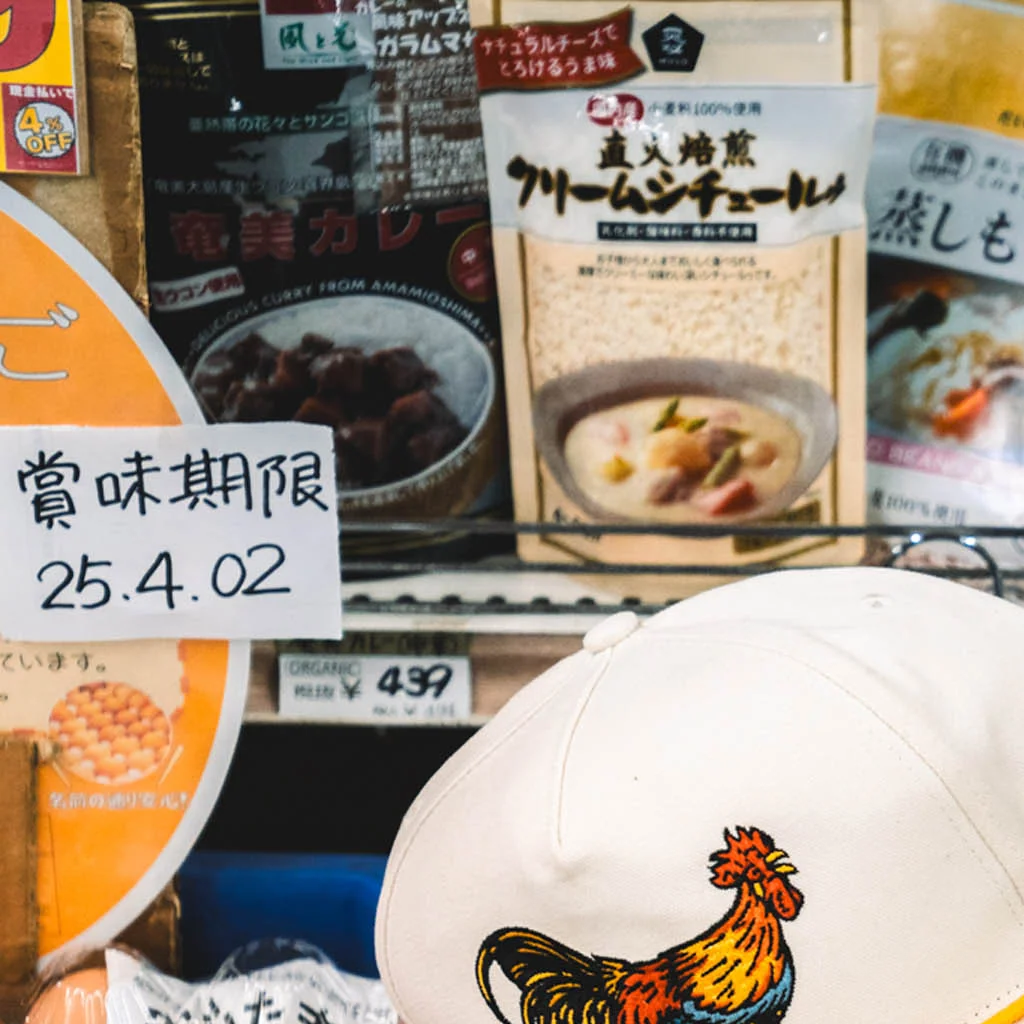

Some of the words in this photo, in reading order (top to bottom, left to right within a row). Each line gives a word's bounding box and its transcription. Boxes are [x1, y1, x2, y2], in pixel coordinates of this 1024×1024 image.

[480, 25, 621, 57] ナチュラルチーズで
[499, 57, 617, 79] とろけるうま味
[8, 84, 75, 99] 現金払いで
[26, 132, 72, 154] OFF
[596, 129, 758, 169] 直火焙煎
[169, 204, 485, 261] 奄美カレー
[262, 284, 314, 307] CURRY
[318, 278, 366, 294] FROM
[18, 449, 328, 529] 賞味期限
[37, 543, 292, 610] 25.4.02
[289, 661, 361, 676] ORGANIC
[376, 663, 453, 698] 439
